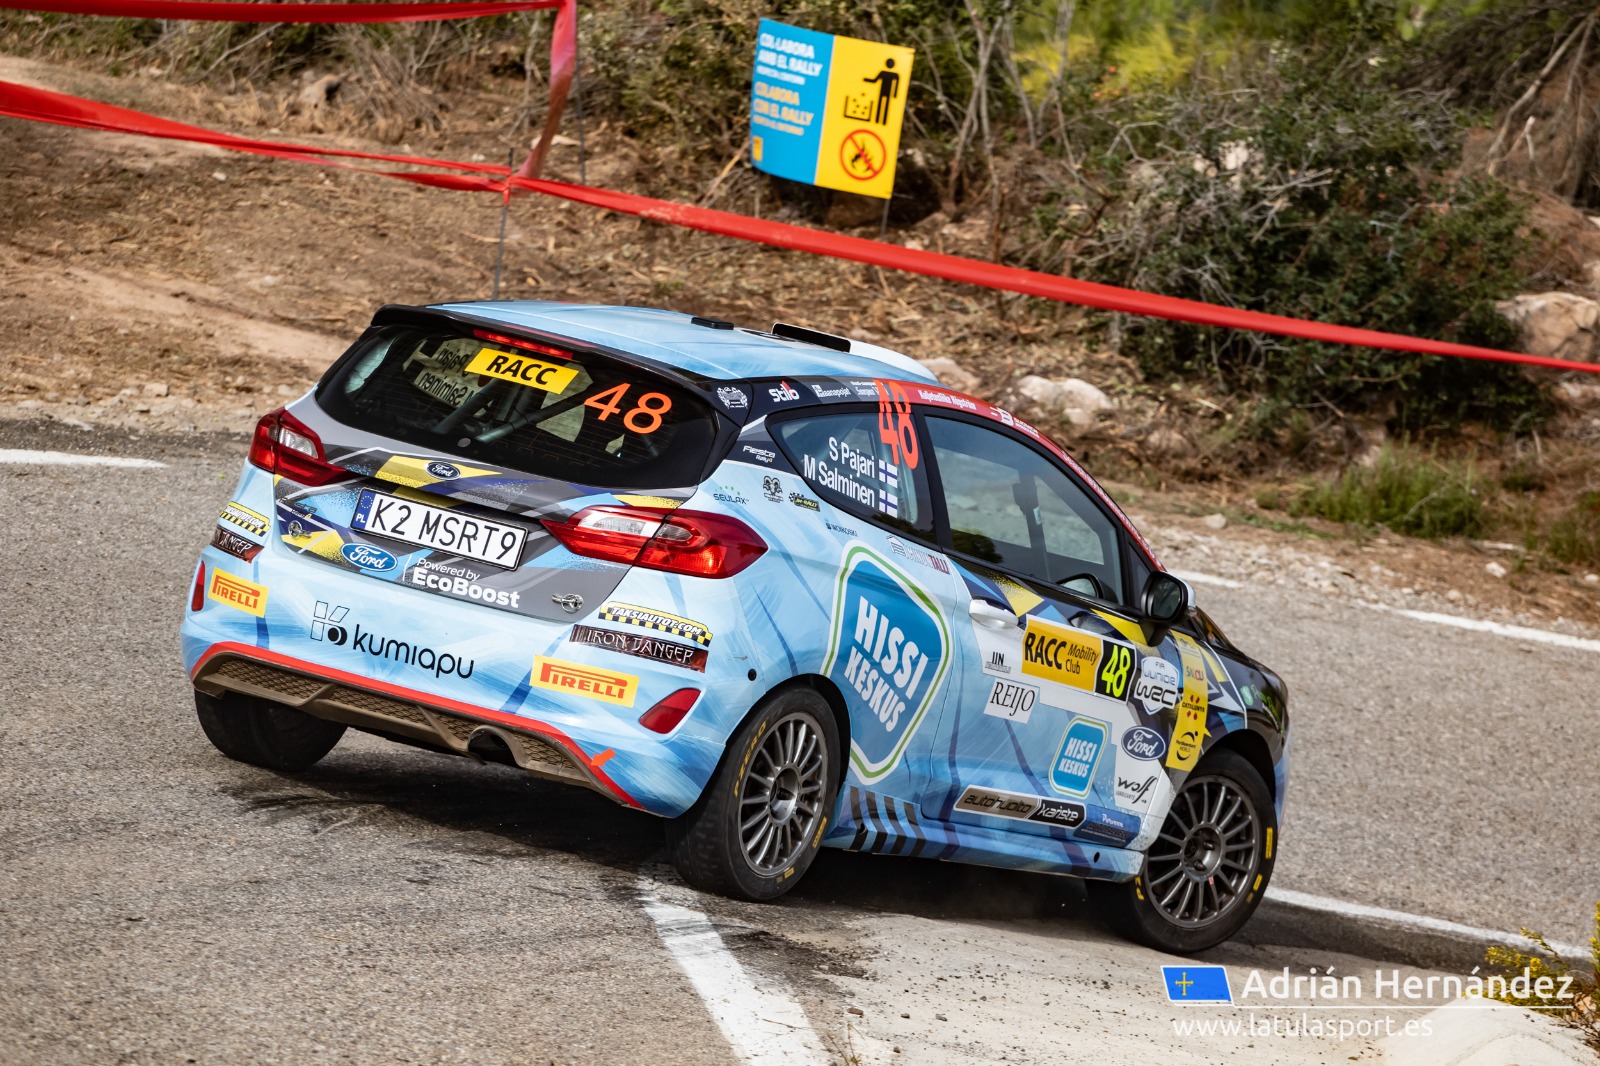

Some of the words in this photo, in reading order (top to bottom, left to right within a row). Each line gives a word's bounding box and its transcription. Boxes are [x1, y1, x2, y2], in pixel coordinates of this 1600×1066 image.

[776, 54, 788, 69] EL
[788, 57, 823, 77] RALLY
[769, 103, 780, 119] EL
[780, 106, 814, 126] RALLY
[485, 355, 558, 385] RACC
[584, 382, 672, 434] 48
[873, 379, 919, 470] 48
[743, 445, 776, 458] Fiesta
[828, 436, 839, 461] S
[841, 441, 876, 479] Pajari
[803, 453, 815, 480] M
[818, 463, 876, 508] Salminen
[355, 513, 367, 524] PL
[371, 498, 413, 536] K2
[418, 516, 518, 561] MSRT9
[346, 545, 388, 571] Ford
[417, 557, 461, 577] Powered
[463, 570, 480, 581] by
[211, 573, 261, 610] PIRELLI
[412, 567, 520, 609] EcoBoost
[610, 605, 703, 635] TAKSIAUTOT.COM
[353, 623, 476, 680] kumiapu
[587, 629, 627, 650] IRON
[631, 637, 694, 664] DANGER
[854, 596, 929, 700] HISSI
[1024, 632, 1068, 671] RACC
[1067, 643, 1101, 666] Mobility
[540, 662, 628, 699] PIRELLI
[1065, 660, 1081, 675] Club
[1102, 644, 1131, 698] 48
[844, 645, 906, 732] KESKUS
[990, 681, 1036, 717] REIJO
[1136, 681, 1176, 707] WRC
[1064, 736, 1097, 763] HISSI
[1127, 731, 1156, 757] Ford
[1058, 758, 1091, 778] KESKUS
